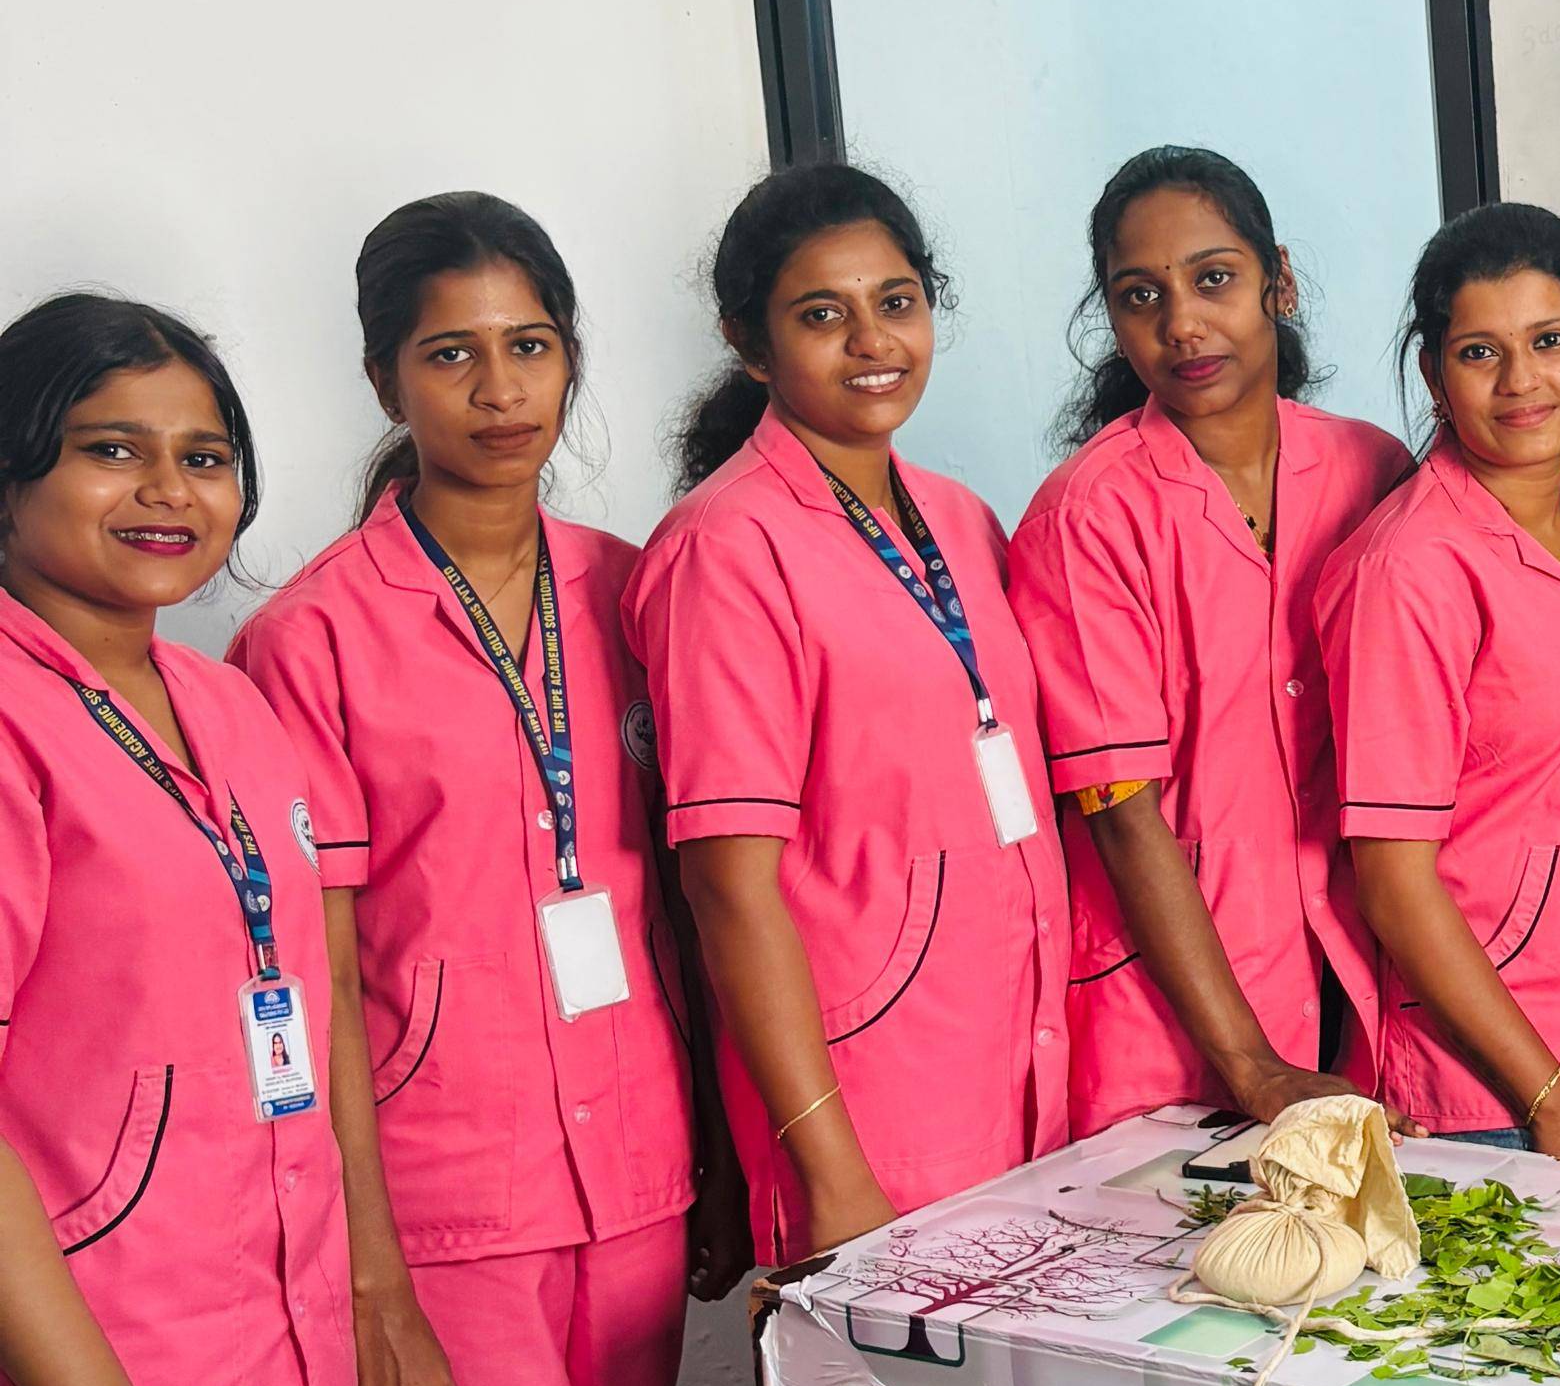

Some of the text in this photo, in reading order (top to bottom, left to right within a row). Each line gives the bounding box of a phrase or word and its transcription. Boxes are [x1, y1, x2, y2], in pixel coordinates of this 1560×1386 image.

[443, 565, 461, 585] LTD
[455, 584, 476, 605] PVT
[539, 573, 557, 629] SOLUTIONS
[470, 603, 507, 657] SOLUTIONS
[500, 656, 535, 710] ACADEMIC
[545, 631, 562, 686] ACADEMIC
[98, 705, 149, 759] ACADEMIC
